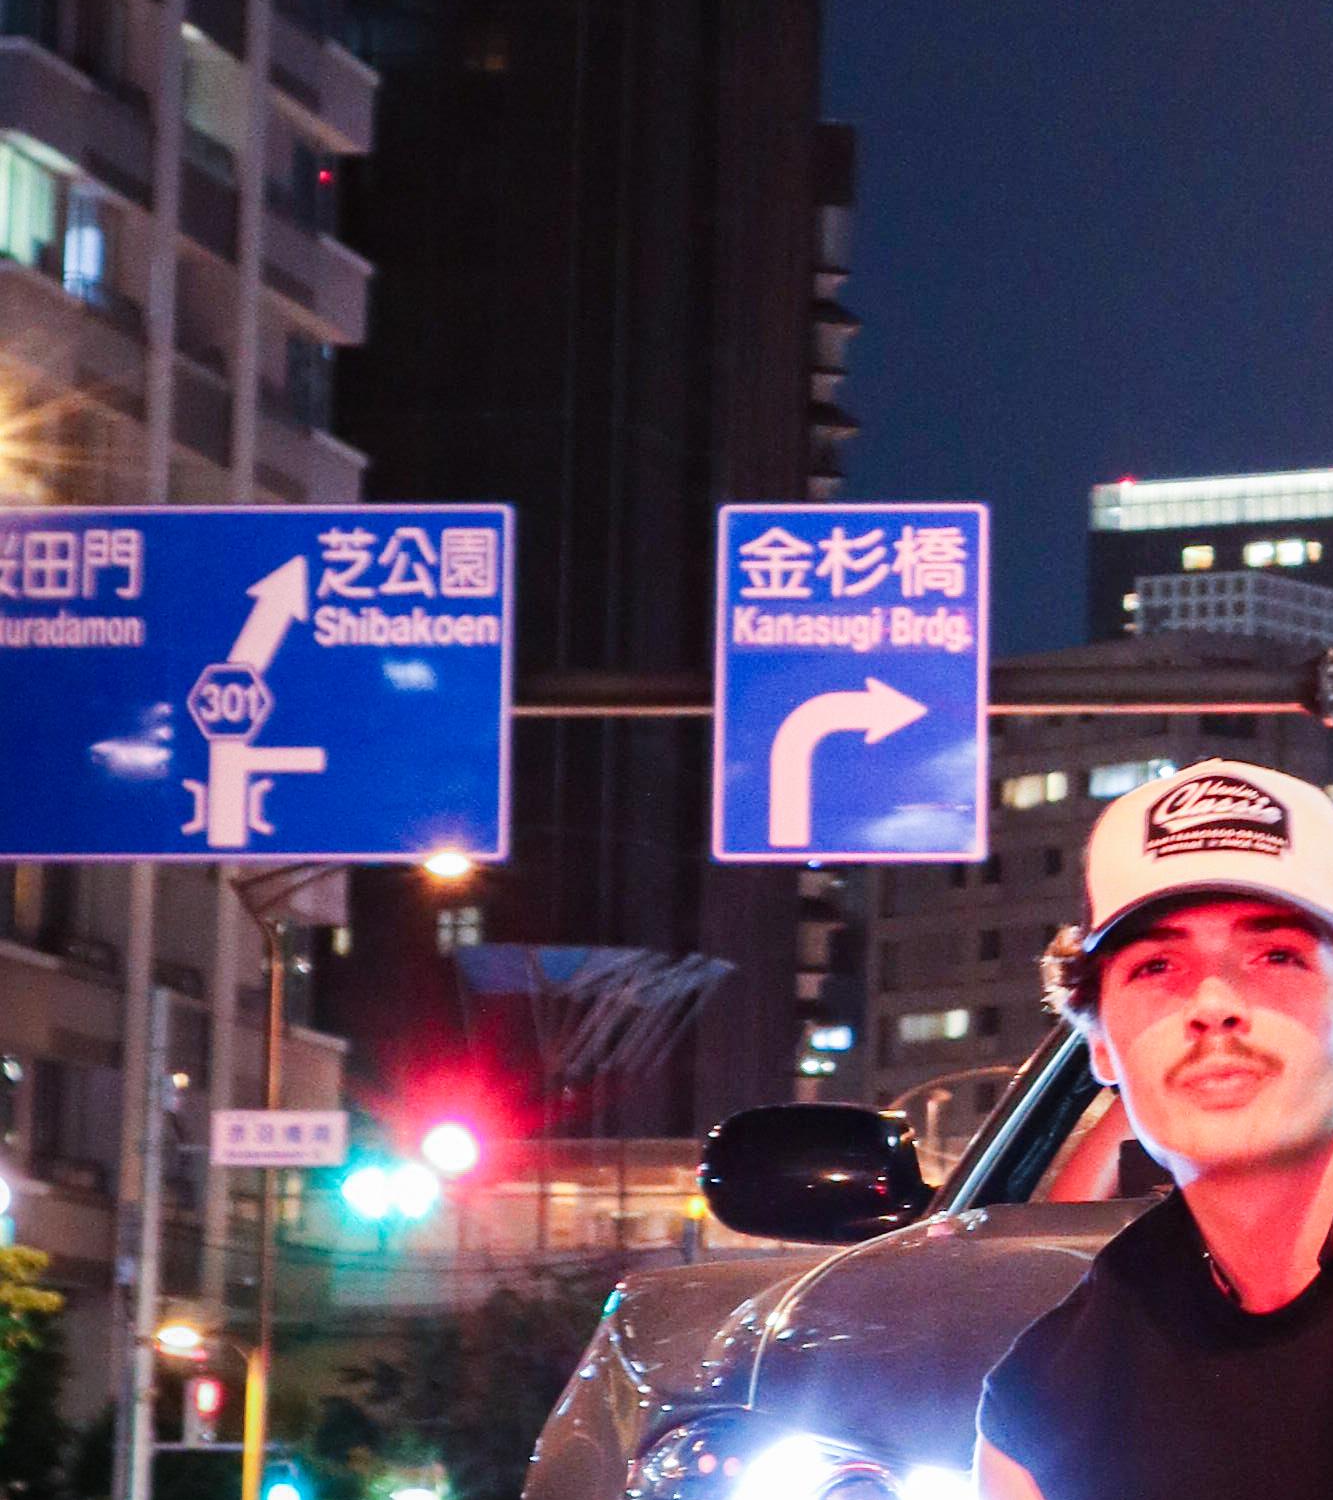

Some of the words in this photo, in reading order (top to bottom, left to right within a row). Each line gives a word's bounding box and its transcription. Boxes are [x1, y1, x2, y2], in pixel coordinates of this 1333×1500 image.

[316, 525, 499, 599] 芝公園
[738, 525, 968, 599] 金杉橋
[0, 607, 142, 648] uradamon
[314, 605, 500, 649] Shibakoen
[732, 605, 882, 653] Kanasugi
[890, 606, 974, 653] Brdg.
[200, 682, 257, 722] 301
